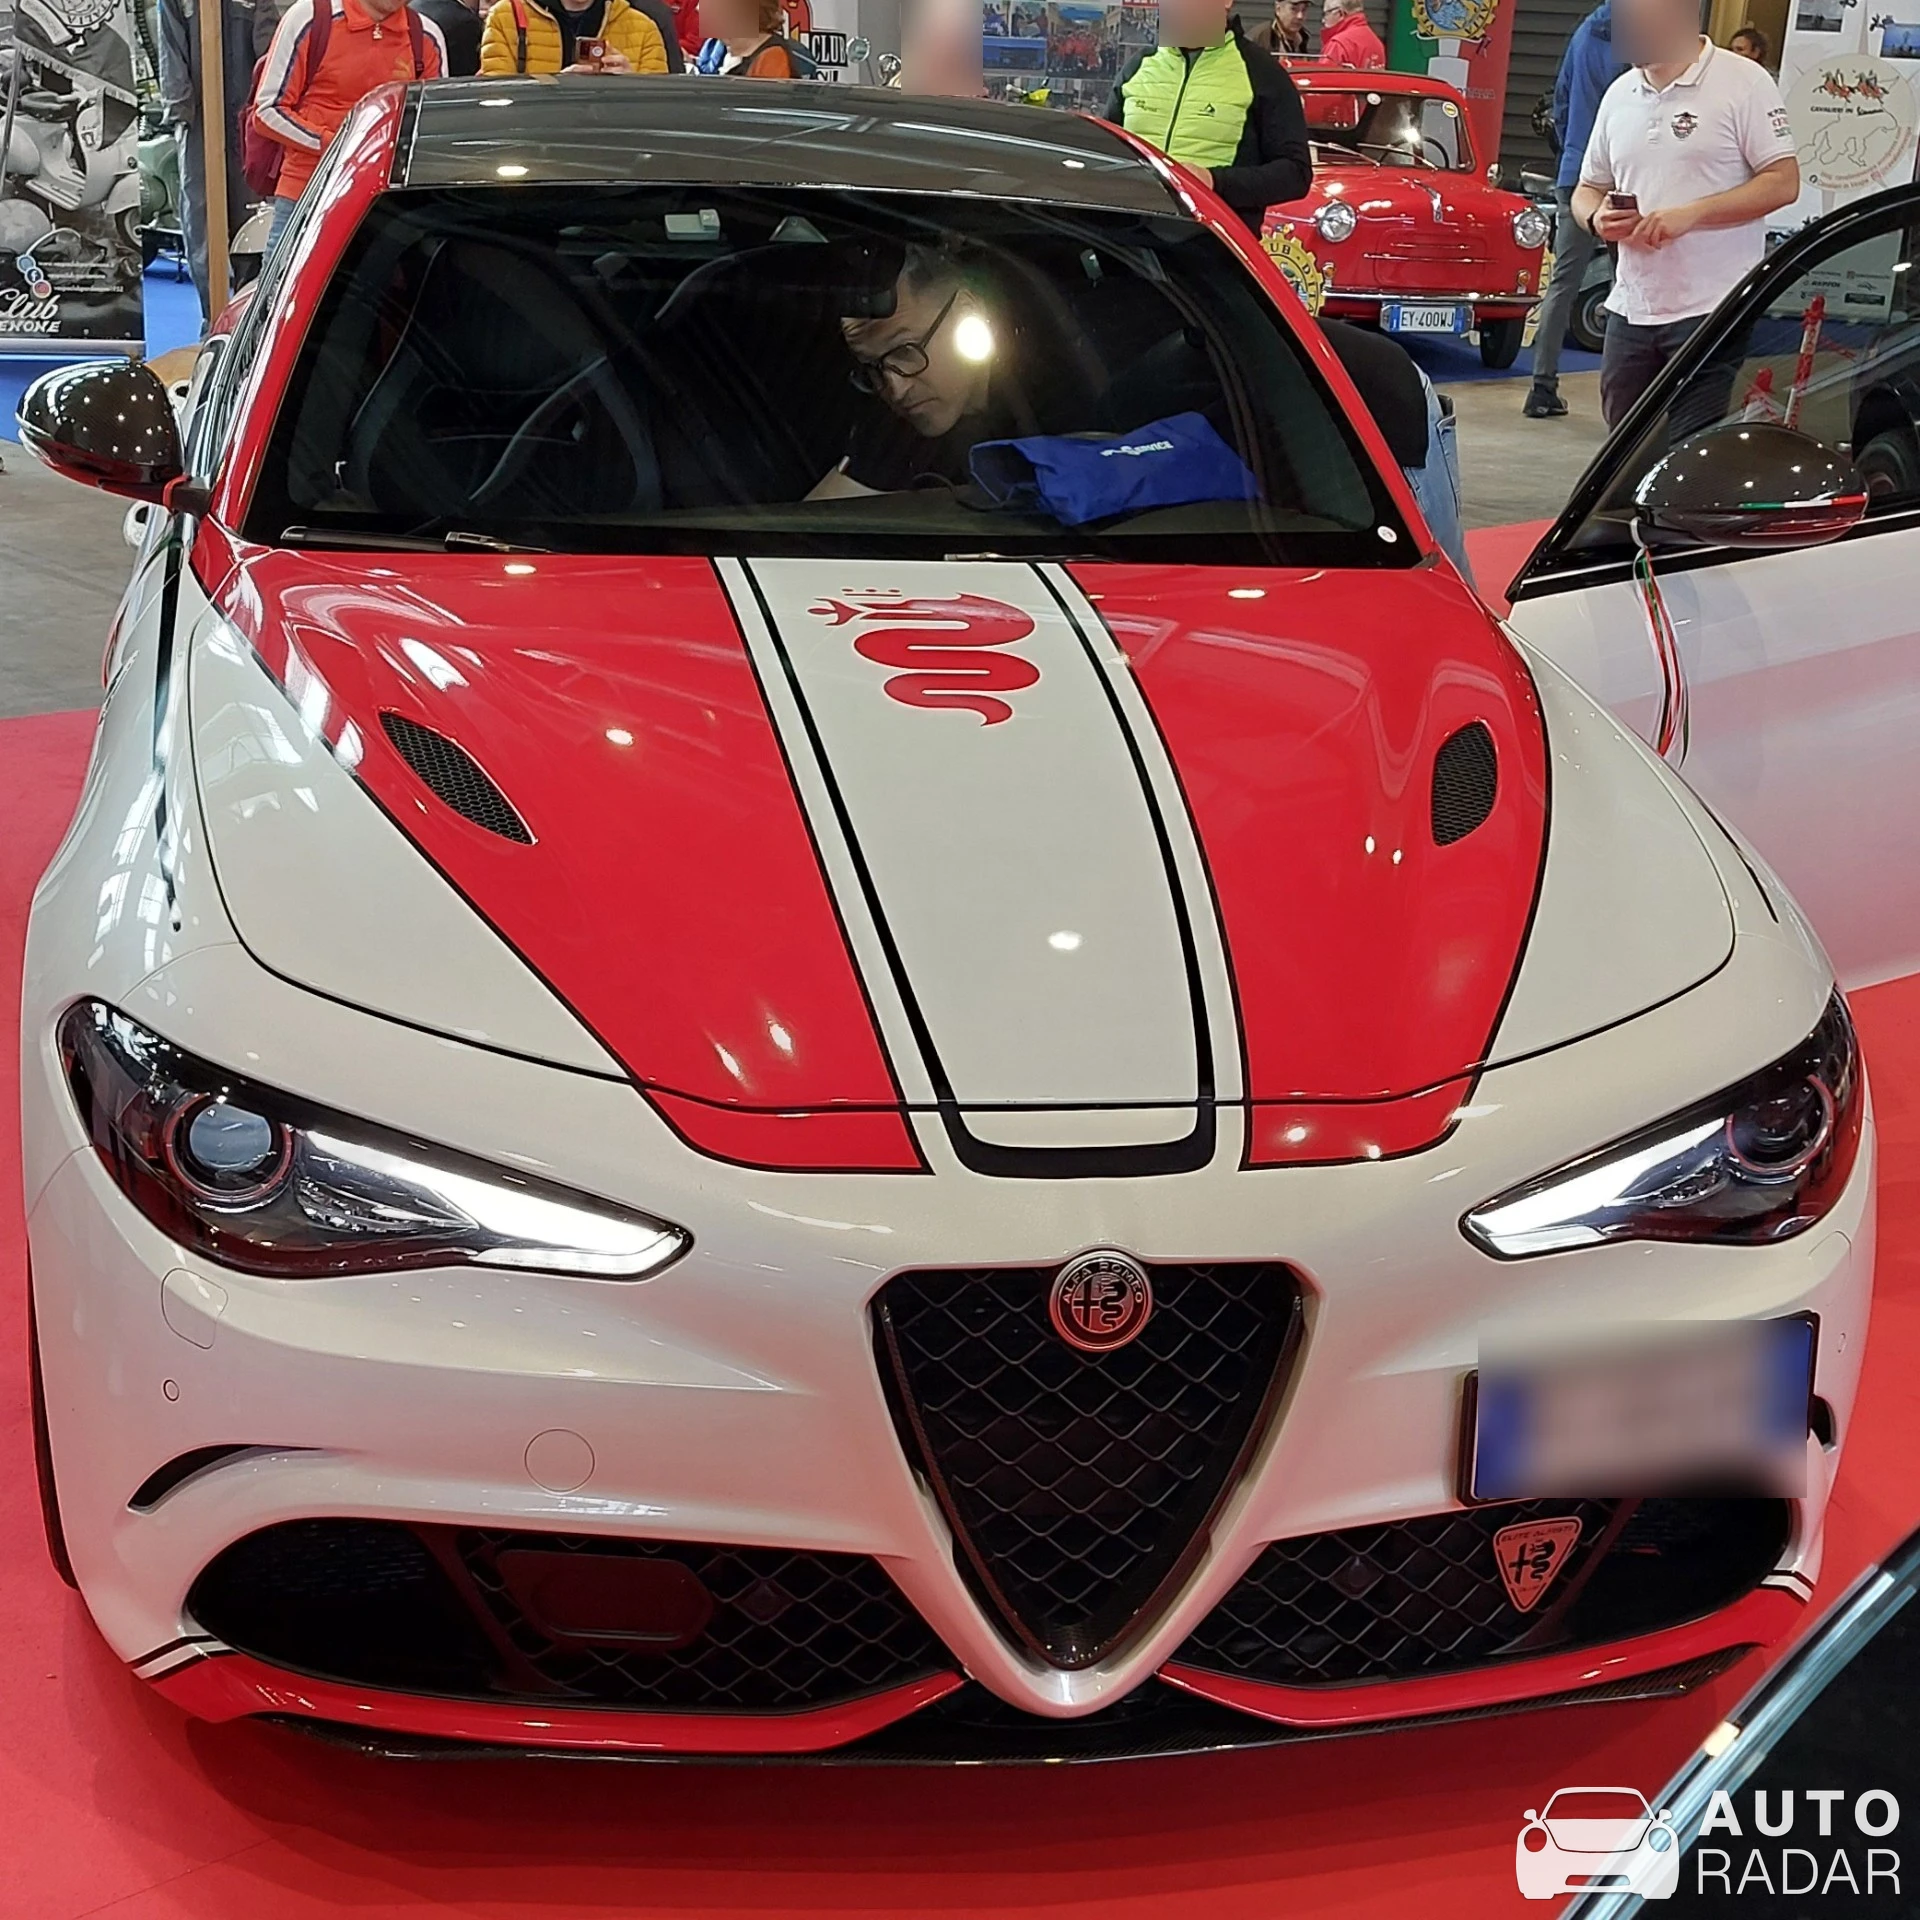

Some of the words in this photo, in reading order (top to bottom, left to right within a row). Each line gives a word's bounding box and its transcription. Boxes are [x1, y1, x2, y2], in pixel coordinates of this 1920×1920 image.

[811, 34, 846, 63] CLUB
[1270, 243, 1291, 255] UB
[1062, 1267, 1092, 1304] ALFA
[1100, 1261, 1143, 1303] ROMEO
